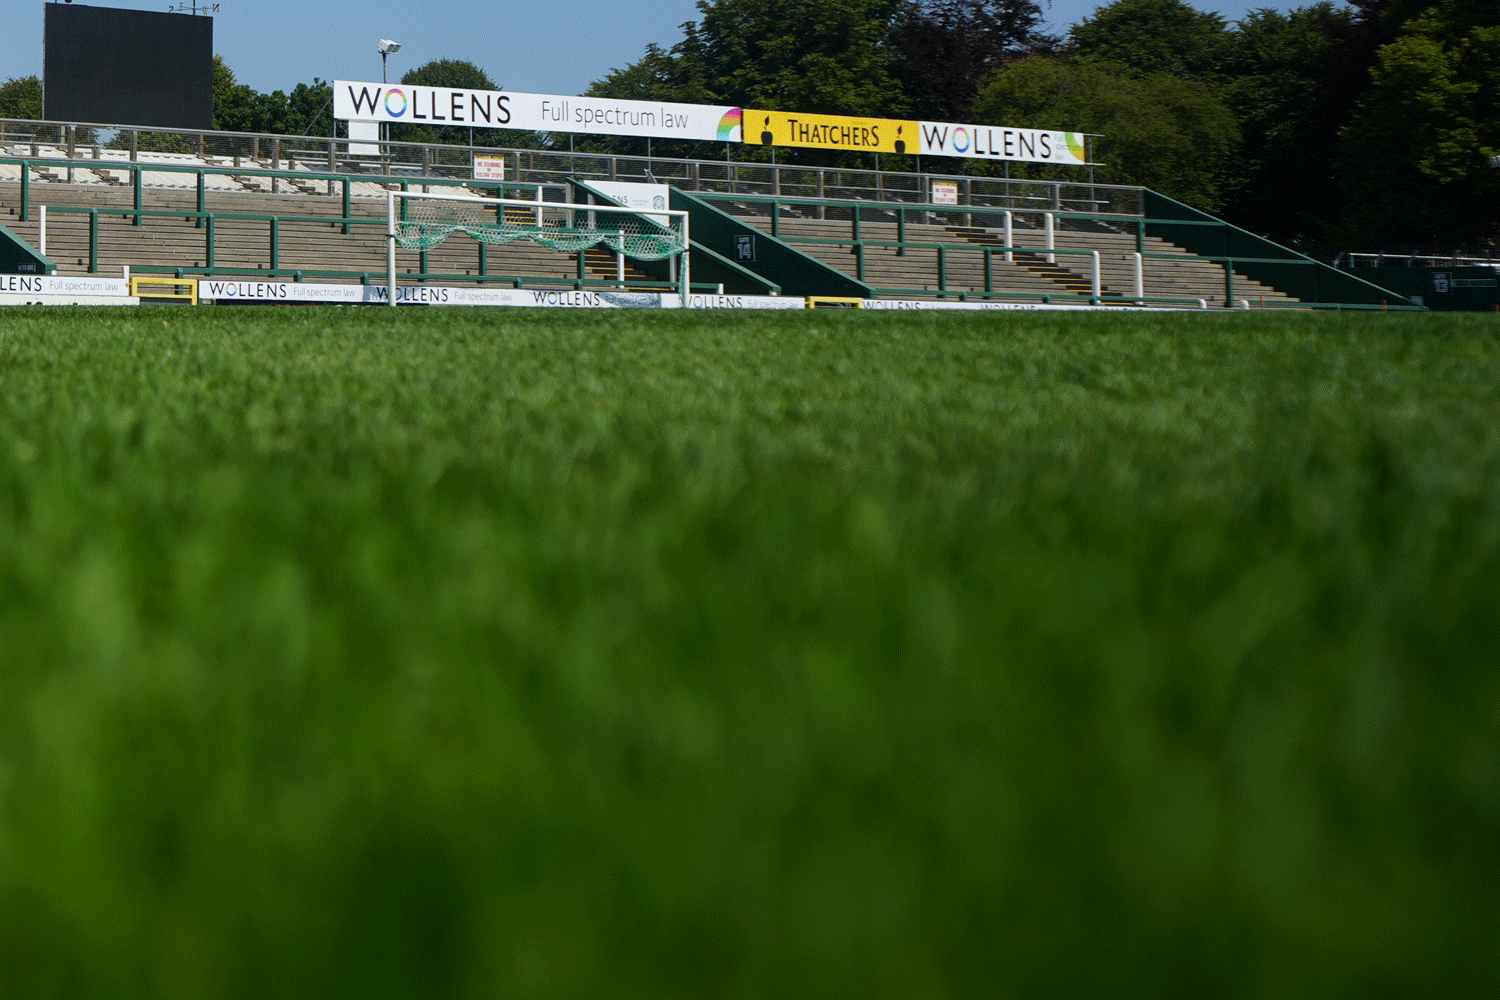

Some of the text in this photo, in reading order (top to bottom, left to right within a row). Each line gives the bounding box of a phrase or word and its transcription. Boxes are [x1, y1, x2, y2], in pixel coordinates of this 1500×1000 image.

[348, 85, 689, 129] WOLLENS Full spectrum law
[787, 119, 880, 147] THATCHERS
[922, 124, 1051, 159] WOLLENS
[737, 243, 752, 260] 14
[49, 280, 63, 290] Full
[65, 281, 102, 292] spectrum
[104, 282, 119, 291] law
[209, 282, 356, 298] WOLLENS Full spectrum law
[533, 291, 600, 306] WOLLENS
